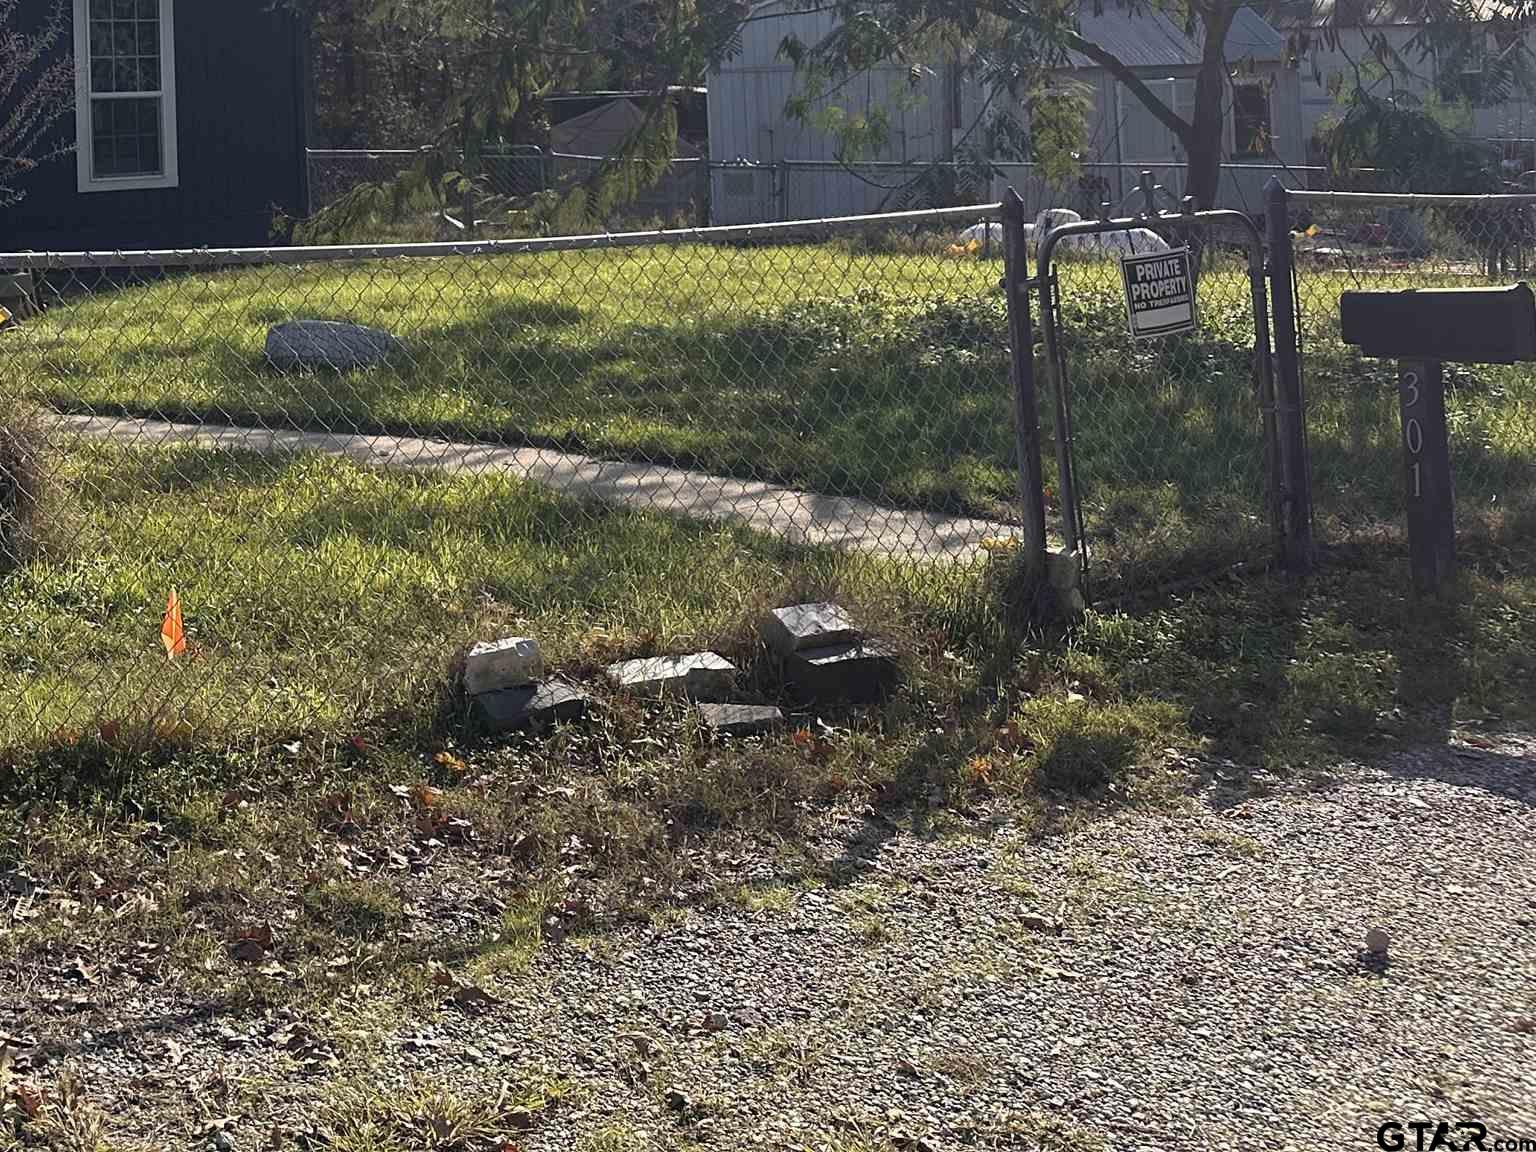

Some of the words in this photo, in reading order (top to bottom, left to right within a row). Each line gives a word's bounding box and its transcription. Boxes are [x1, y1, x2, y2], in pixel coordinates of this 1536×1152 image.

[1137, 258, 1181, 281] PRIVATE
[1132, 277, 1186, 301] PROPERTY
[1134, 301, 1147, 310] NO
[1404, 372, 1423, 497] 301
